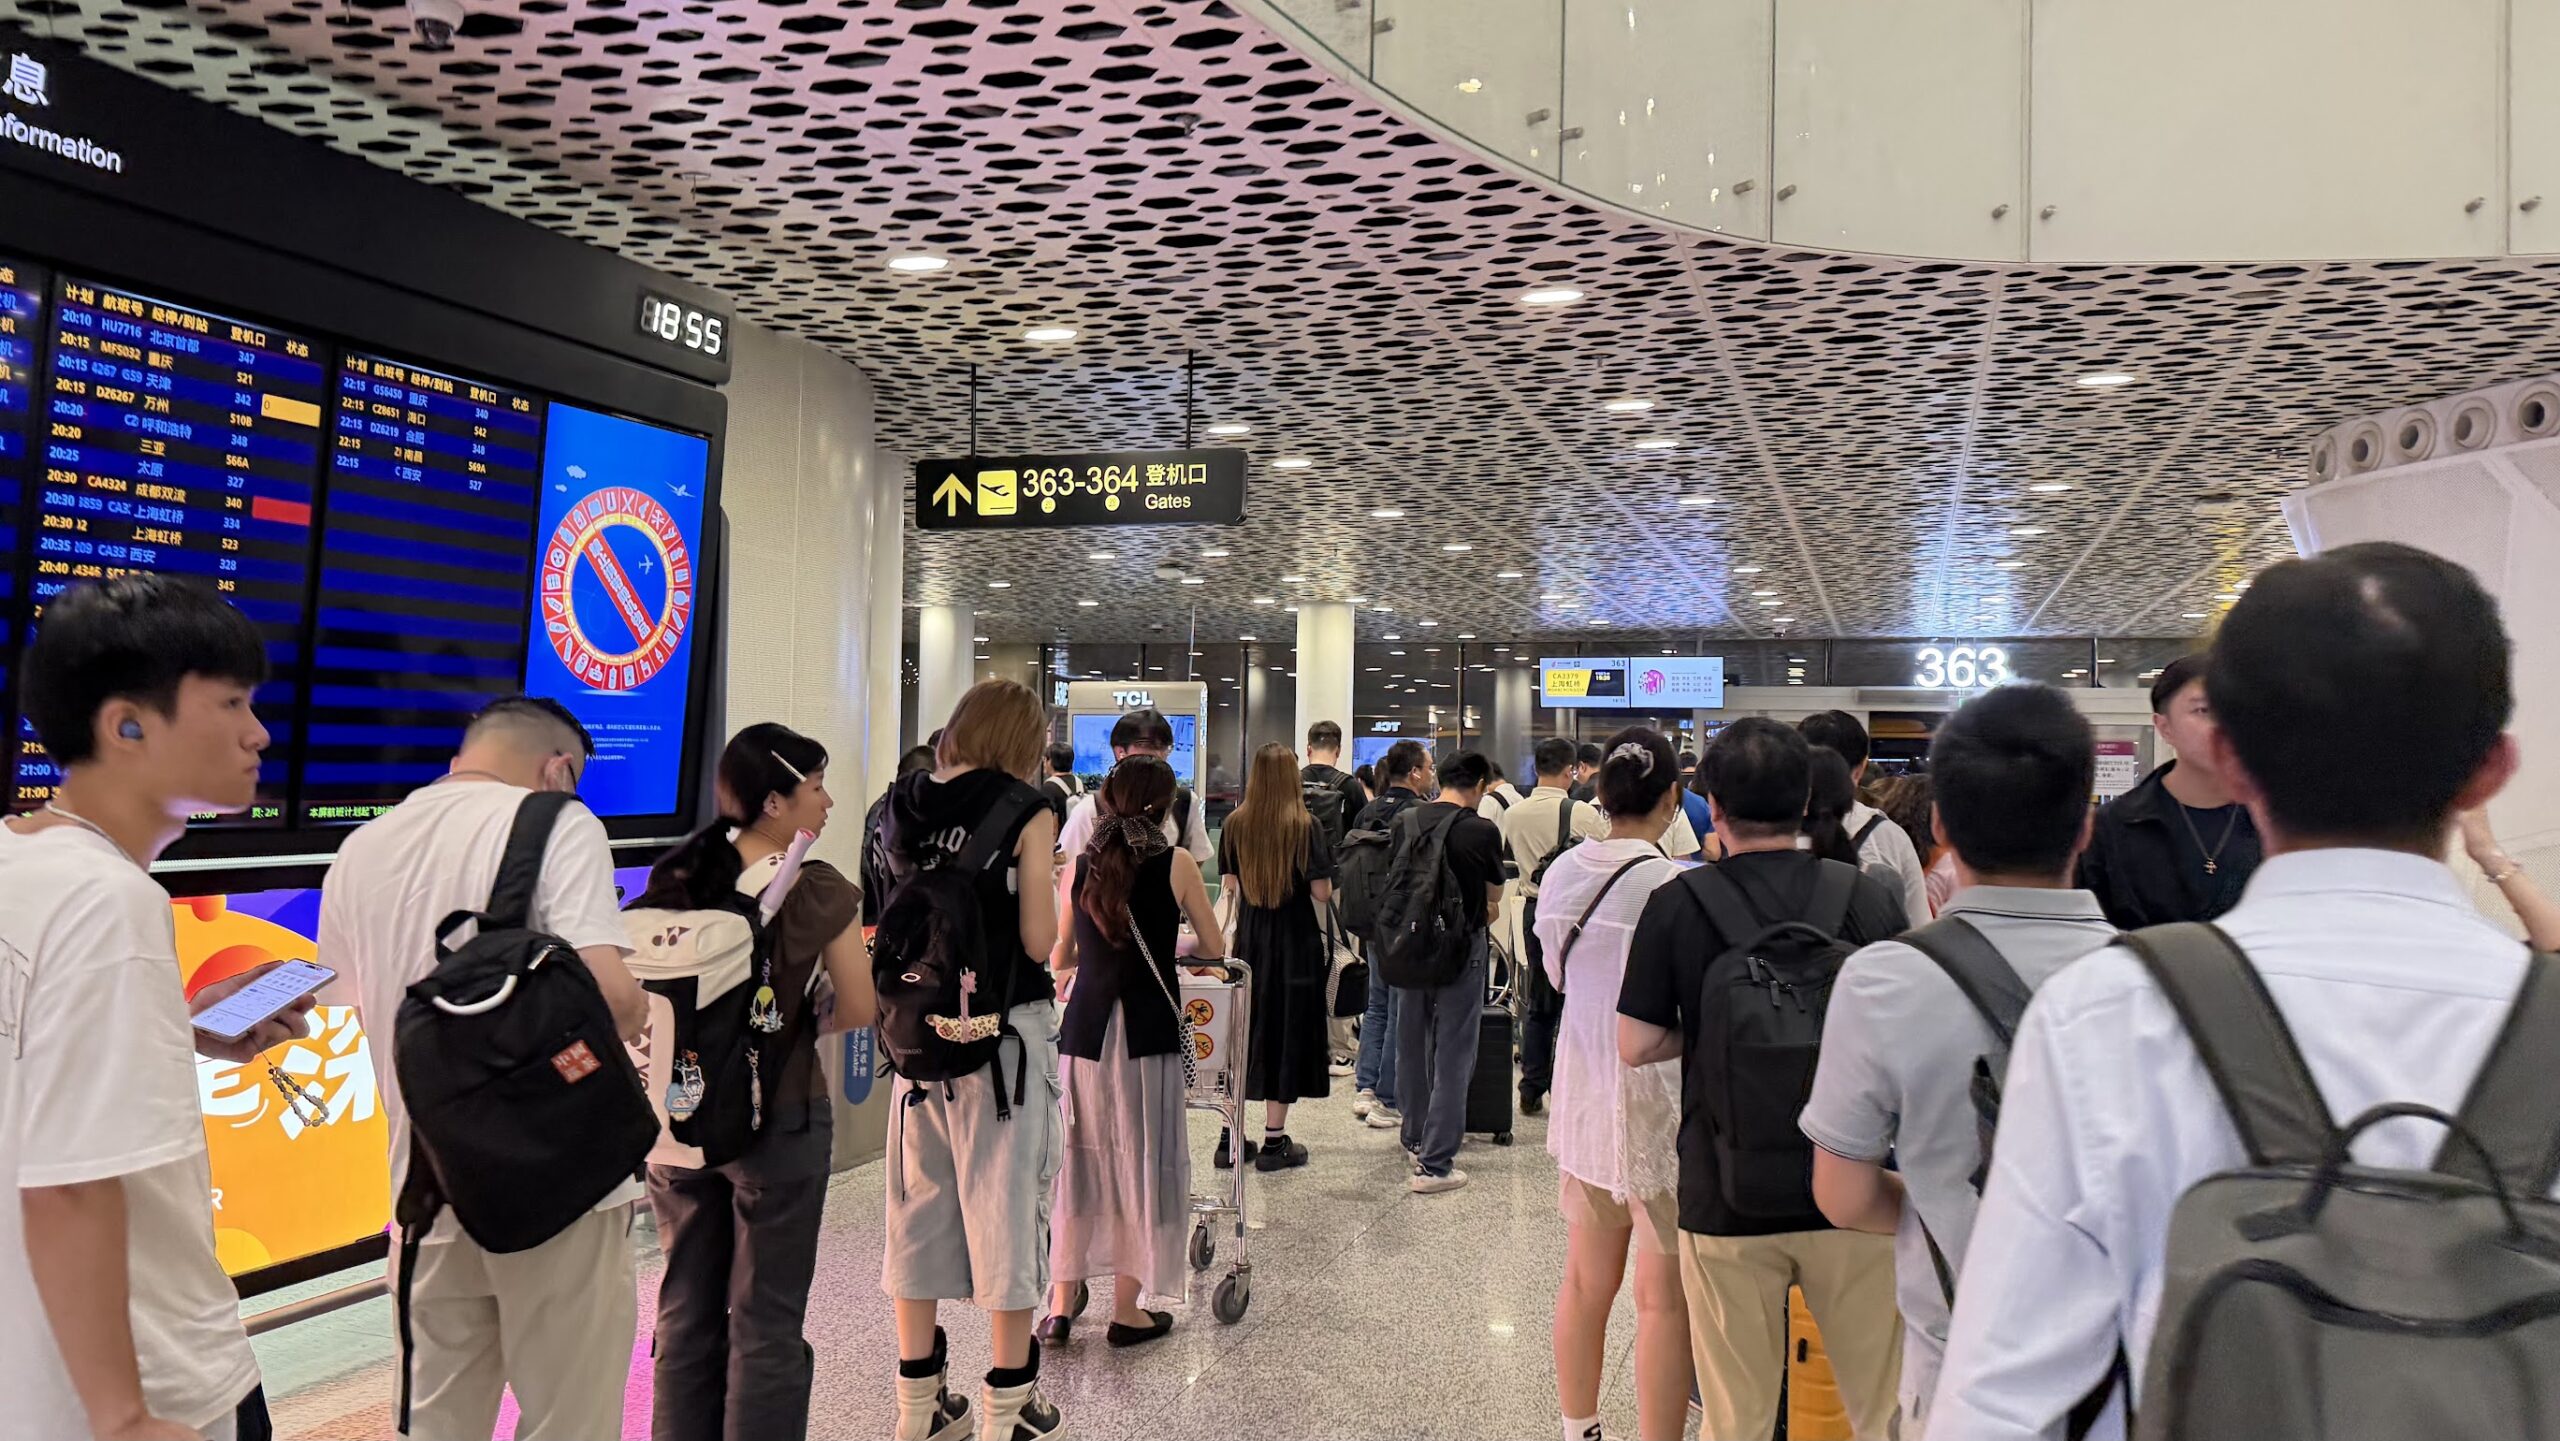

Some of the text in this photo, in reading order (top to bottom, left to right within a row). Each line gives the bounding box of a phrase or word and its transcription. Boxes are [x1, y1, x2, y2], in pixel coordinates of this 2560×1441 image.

[1, 52, 49, 106] 息
[62, 309, 255, 366] 20:10 HU7716 北京首都 347
[66, 283, 94, 306] 计划
[103, 294, 144, 318] 航班号
[230, 326, 266, 349] 登机口
[286, 339, 309, 358] 状态
[60, 332, 90, 349] 20:15
[148, 351, 174, 371] 重庆
[236, 371, 253, 386] 521
[56, 377, 86, 395] 20:15
[144, 395, 170, 413] 万州
[58, 355, 88, 373] 20:15
[146, 373, 172, 392] 天津
[234, 392, 251, 406] 342
[343, 377, 366, 392] 22:15
[409, 393, 429, 408] 重庆
[475, 408, 489, 420] 340
[346, 355, 368, 374] 计划
[374, 363, 405, 382] 航班号
[469, 387, 497, 405] 登机口
[512, 397, 530, 412] 状态
[54, 400, 84, 417] 20:20
[231, 434, 248, 448] 348
[340, 416, 363, 430] 22:15
[405, 430, 425, 446] 合肥
[472, 443, 486, 456] 348
[342, 397, 364, 412] 22:15
[473, 426, 487, 438] 542
[52, 423, 82, 440] 20:20
[139, 438, 166, 456] 三亚
[338, 435, 361, 450] 22:15
[49, 446, 244, 490] 20:25 太原 327
[337, 455, 359, 469] 22:15
[402, 466, 422, 482] 西安
[469, 479, 482, 492] 527
[1022, 463, 1207, 498] 363-364 登机口
[47, 468, 242, 510] 20:30 CA4324 成都双流 340
[1144, 493, 1191, 510] Gates
[45, 491, 75, 507] 20:30
[134, 504, 184, 525] 上海虹桥
[223, 516, 240, 530] 334
[43, 514, 73, 531] 20:30
[132, 526, 183, 546] 上海虹桥
[221, 537, 239, 551] 523
[40, 536, 71, 553] 20:35
[130, 547, 156, 564] 西安
[219, 558, 237, 571] 328
[38, 559, 69, 575] 20:40
[217, 579, 235, 592] 345
[1917, 647, 2008, 688] 363
[1113, 691, 1153, 706] TCL
[19, 763, 51, 776] 21:00
[17, 786, 49, 799] 21:00
